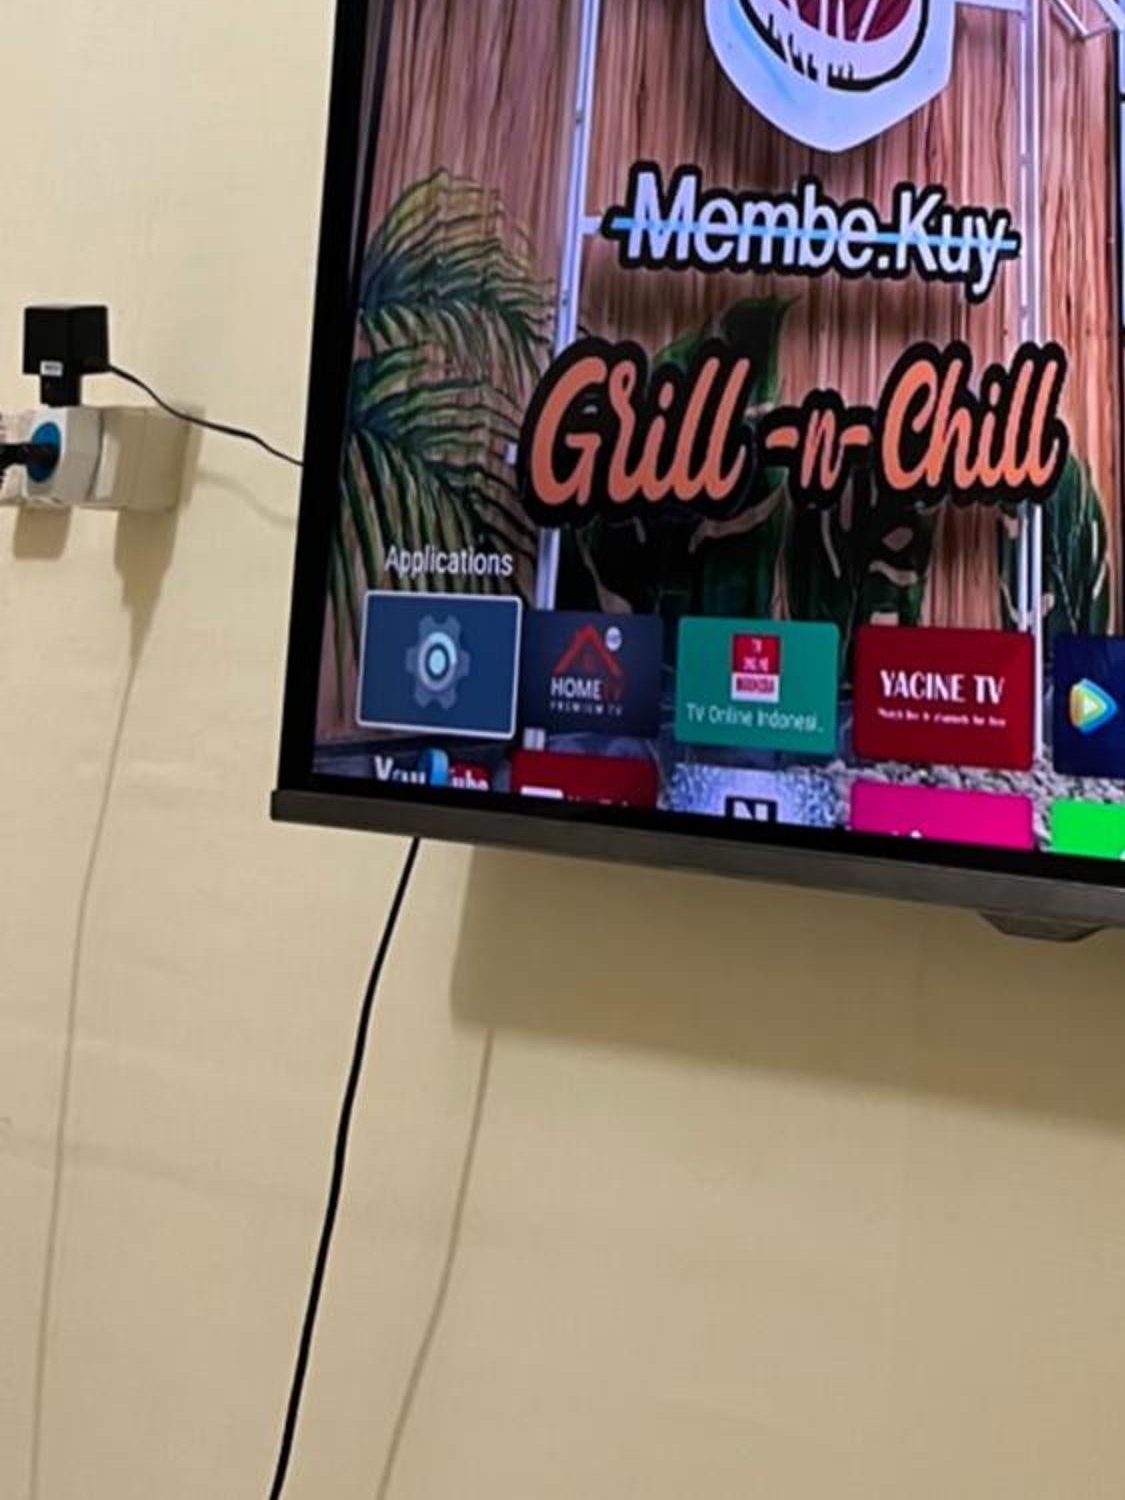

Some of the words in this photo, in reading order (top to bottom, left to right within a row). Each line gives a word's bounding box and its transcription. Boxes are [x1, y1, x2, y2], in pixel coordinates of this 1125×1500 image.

[616, 170, 1014, 296] Membe.Kuy
[530, 355, 752, 507] Grill
[880, 357, 1060, 493] Chill
[384, 544, 514, 579] Applications
[550, 676, 602, 701] HOME
[879, 669, 967, 703] YACINE
[973, 674, 1005, 706] TV
[685, 702, 705, 724] TV
[708, 703, 753, 728] Online
